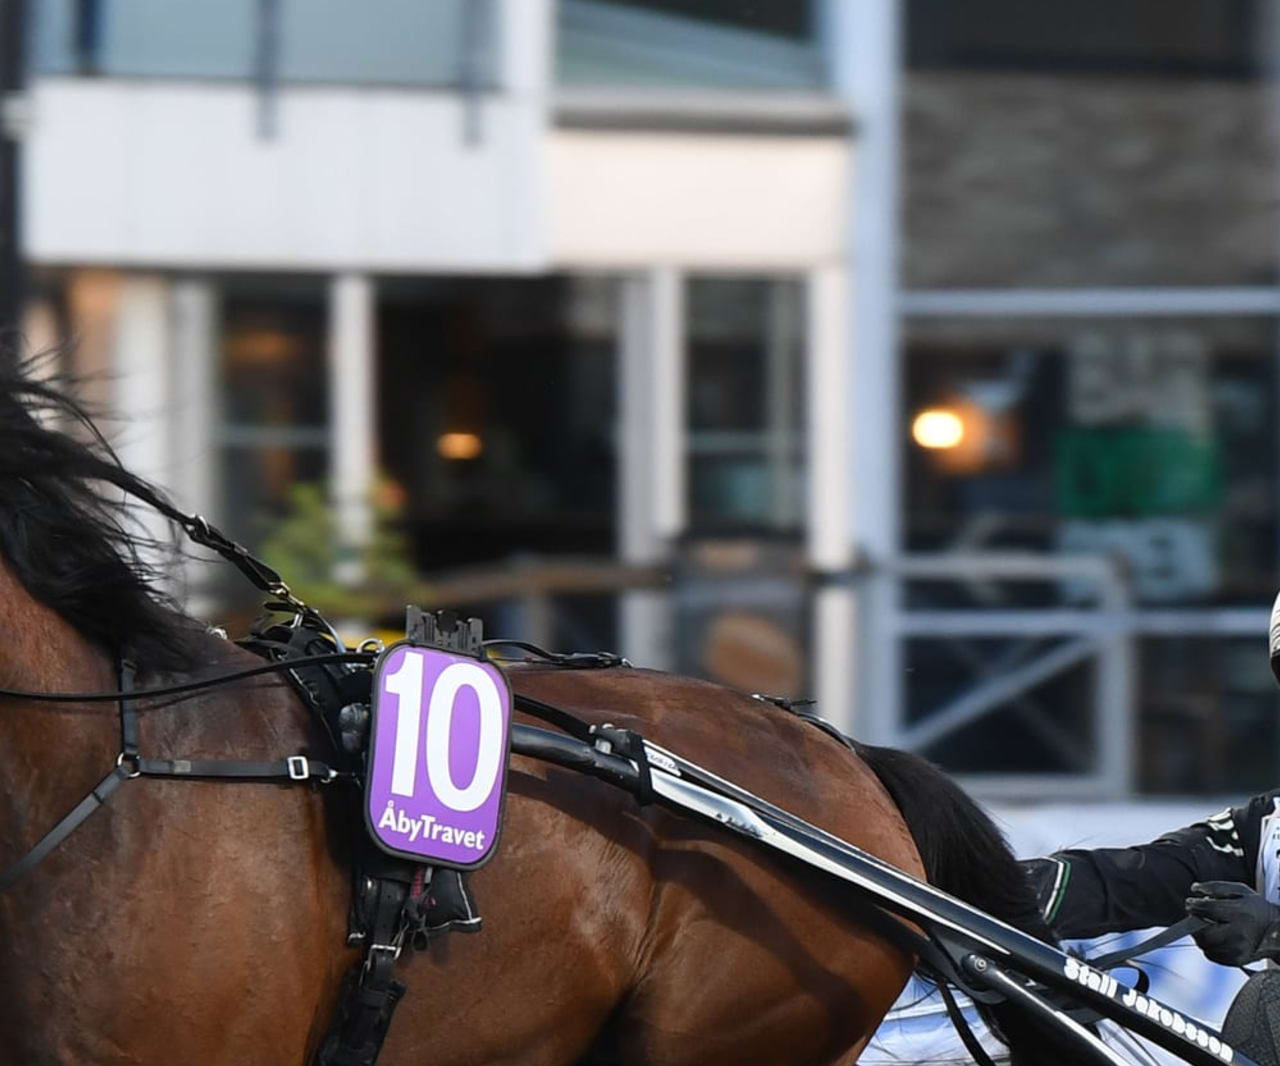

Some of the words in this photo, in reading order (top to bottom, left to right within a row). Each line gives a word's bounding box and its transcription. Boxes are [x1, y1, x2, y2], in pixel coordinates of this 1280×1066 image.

[386, 652, 503, 812] 10
[379, 800, 485, 850] ÅbyTravet
[1063, 957, 1118, 998] Stall
[1122, 988, 1234, 1063] Jakobsson
